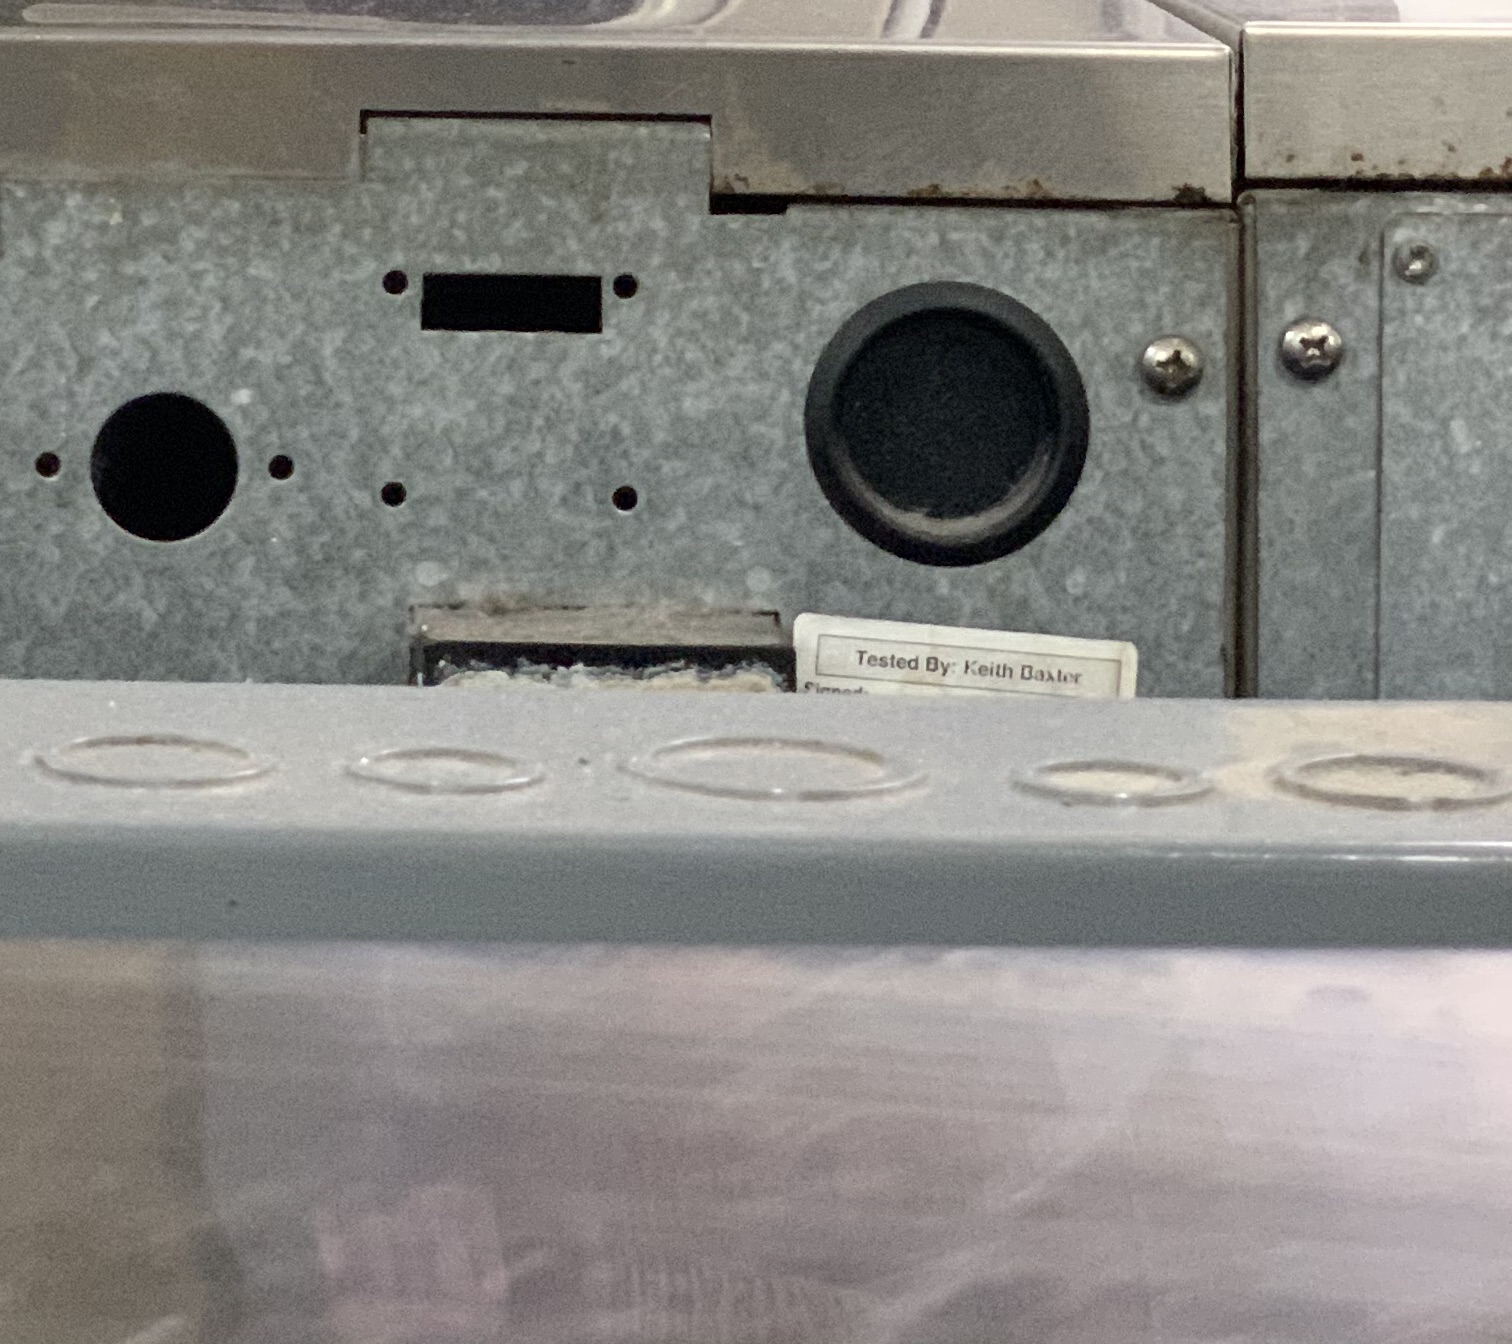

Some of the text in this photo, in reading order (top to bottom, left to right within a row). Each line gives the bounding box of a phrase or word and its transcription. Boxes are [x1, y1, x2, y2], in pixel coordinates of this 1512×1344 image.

[855, 649, 920, 671] Tested
[925, 655, 957, 677] By:
[963, 659, 1015, 680] Keith
